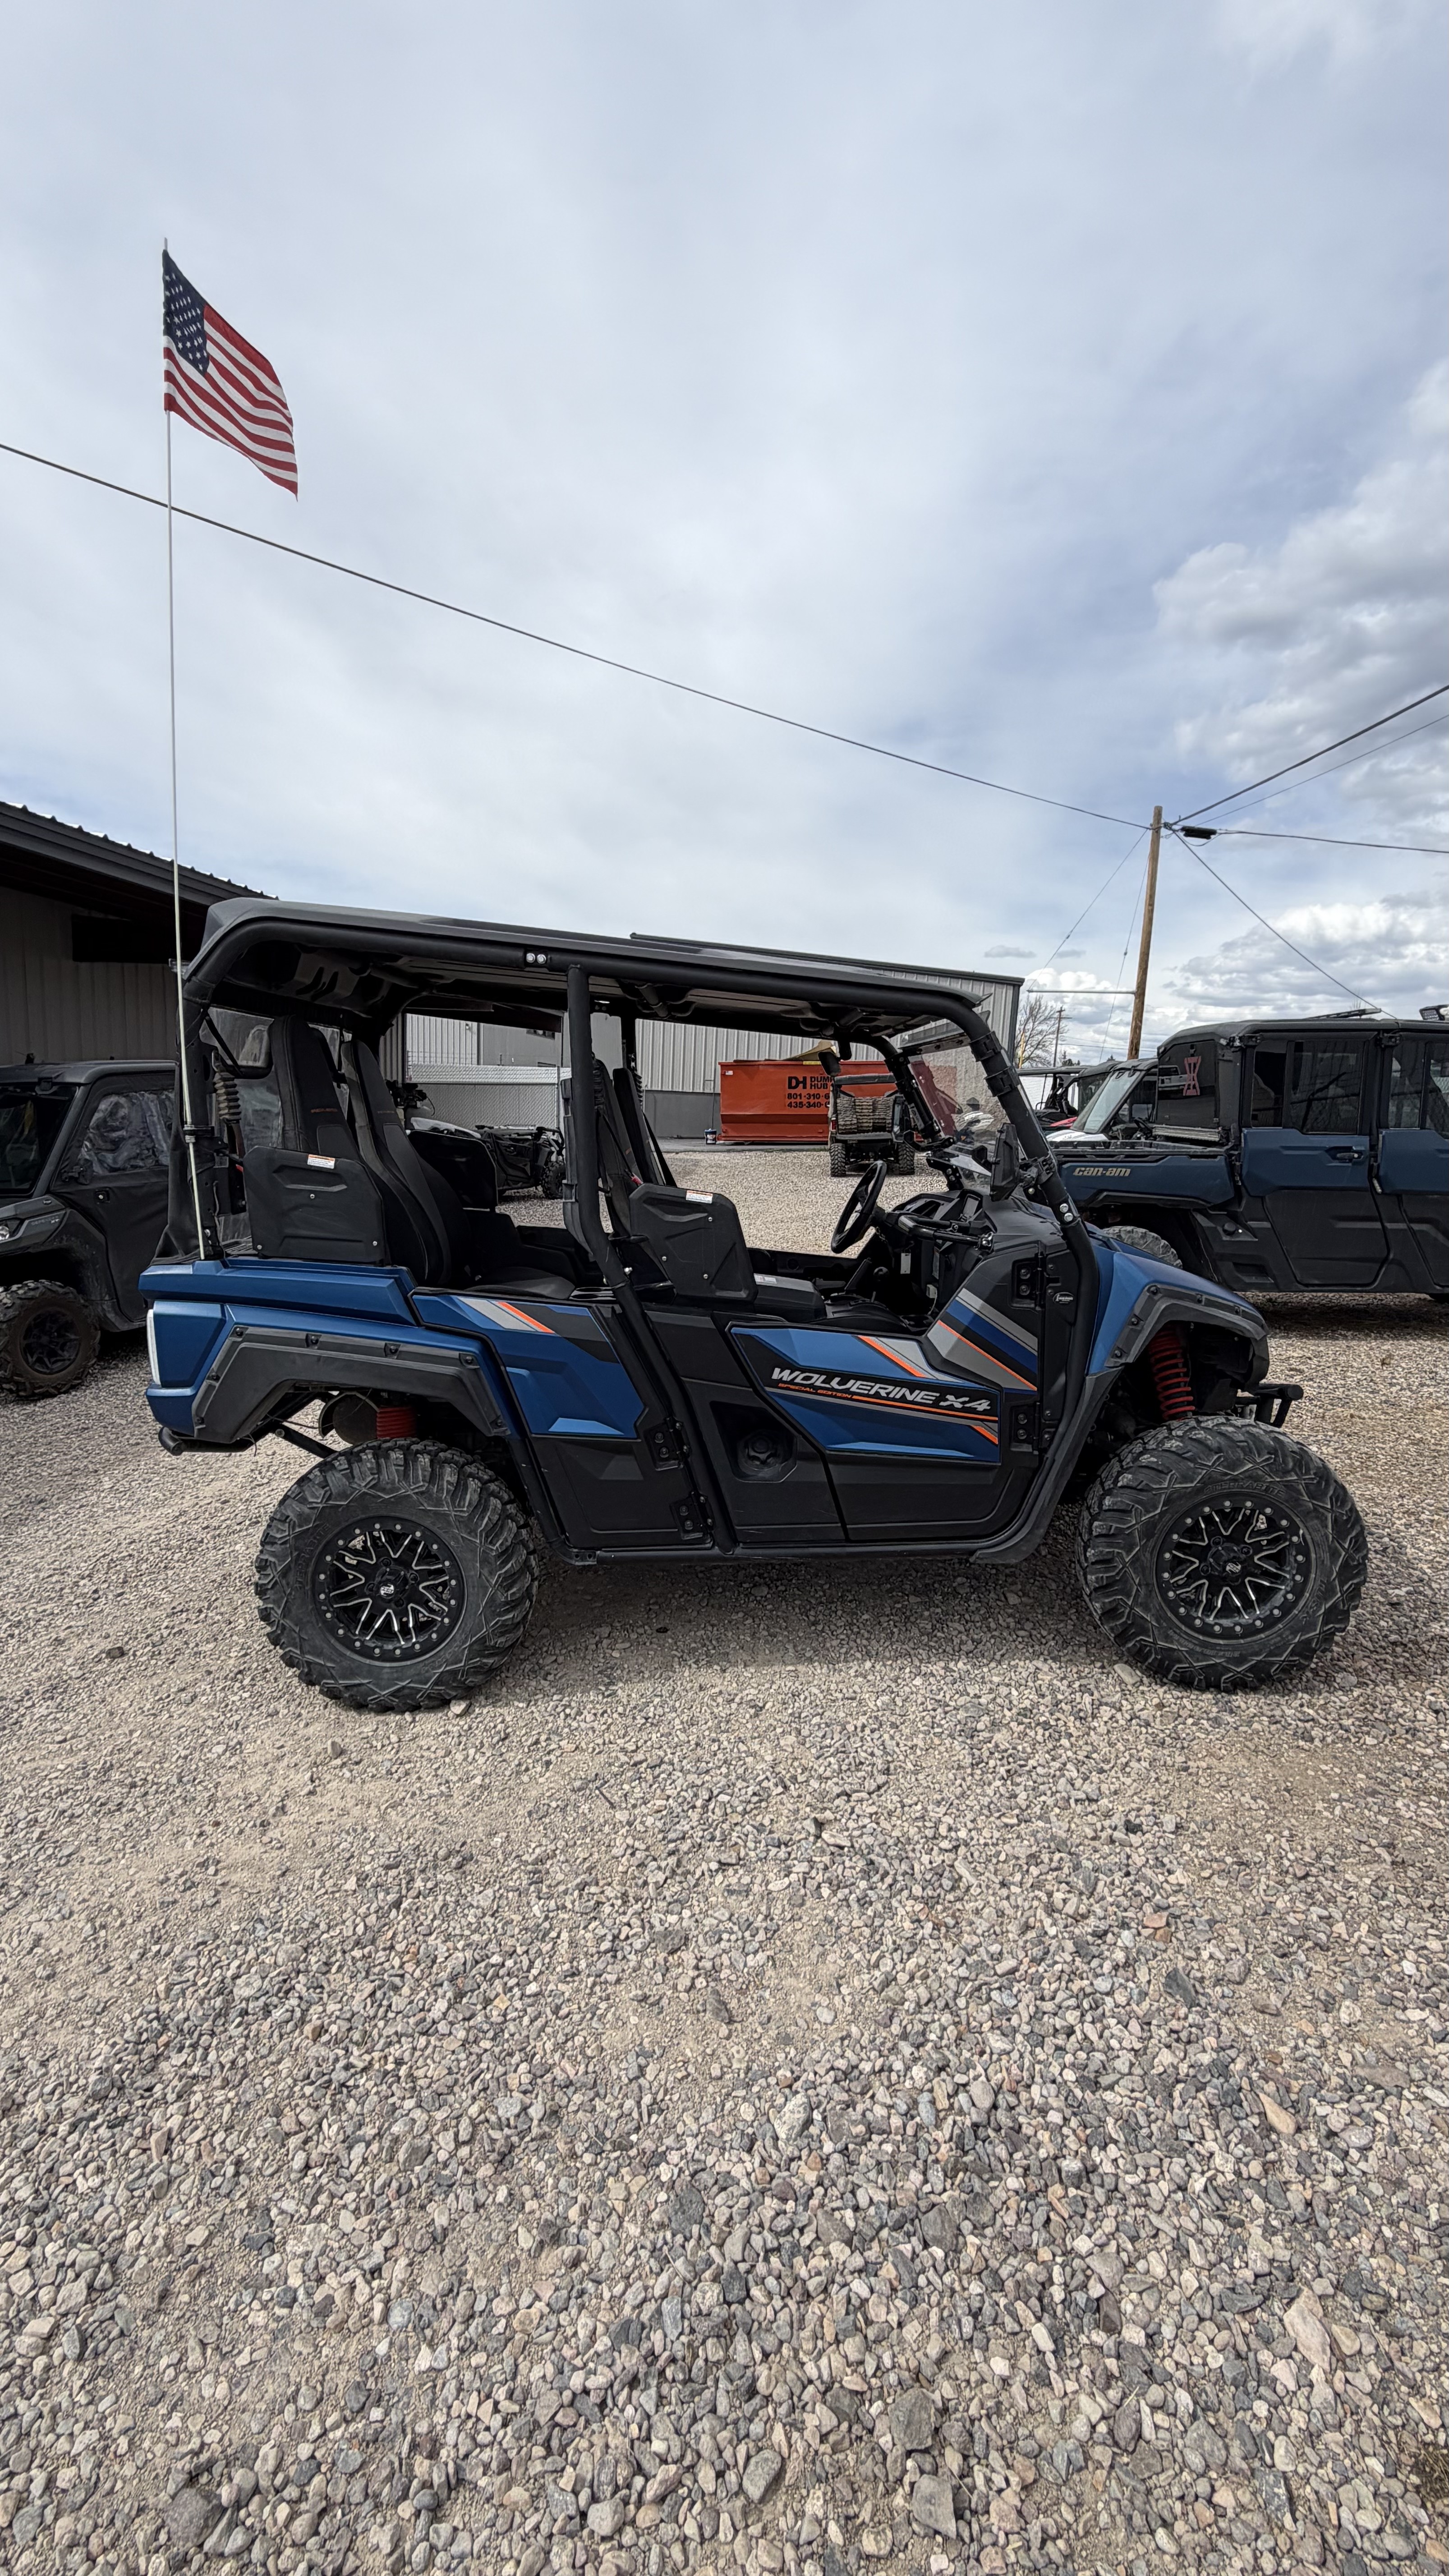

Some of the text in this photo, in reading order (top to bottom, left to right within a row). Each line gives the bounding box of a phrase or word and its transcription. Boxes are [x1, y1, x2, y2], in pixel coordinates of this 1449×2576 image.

[1072, 1167, 1131, 1177] can-am
[771, 1367, 991, 1411] WOLVERINE X4
[777, 1383, 852, 1398] SPECIAL EDITION
